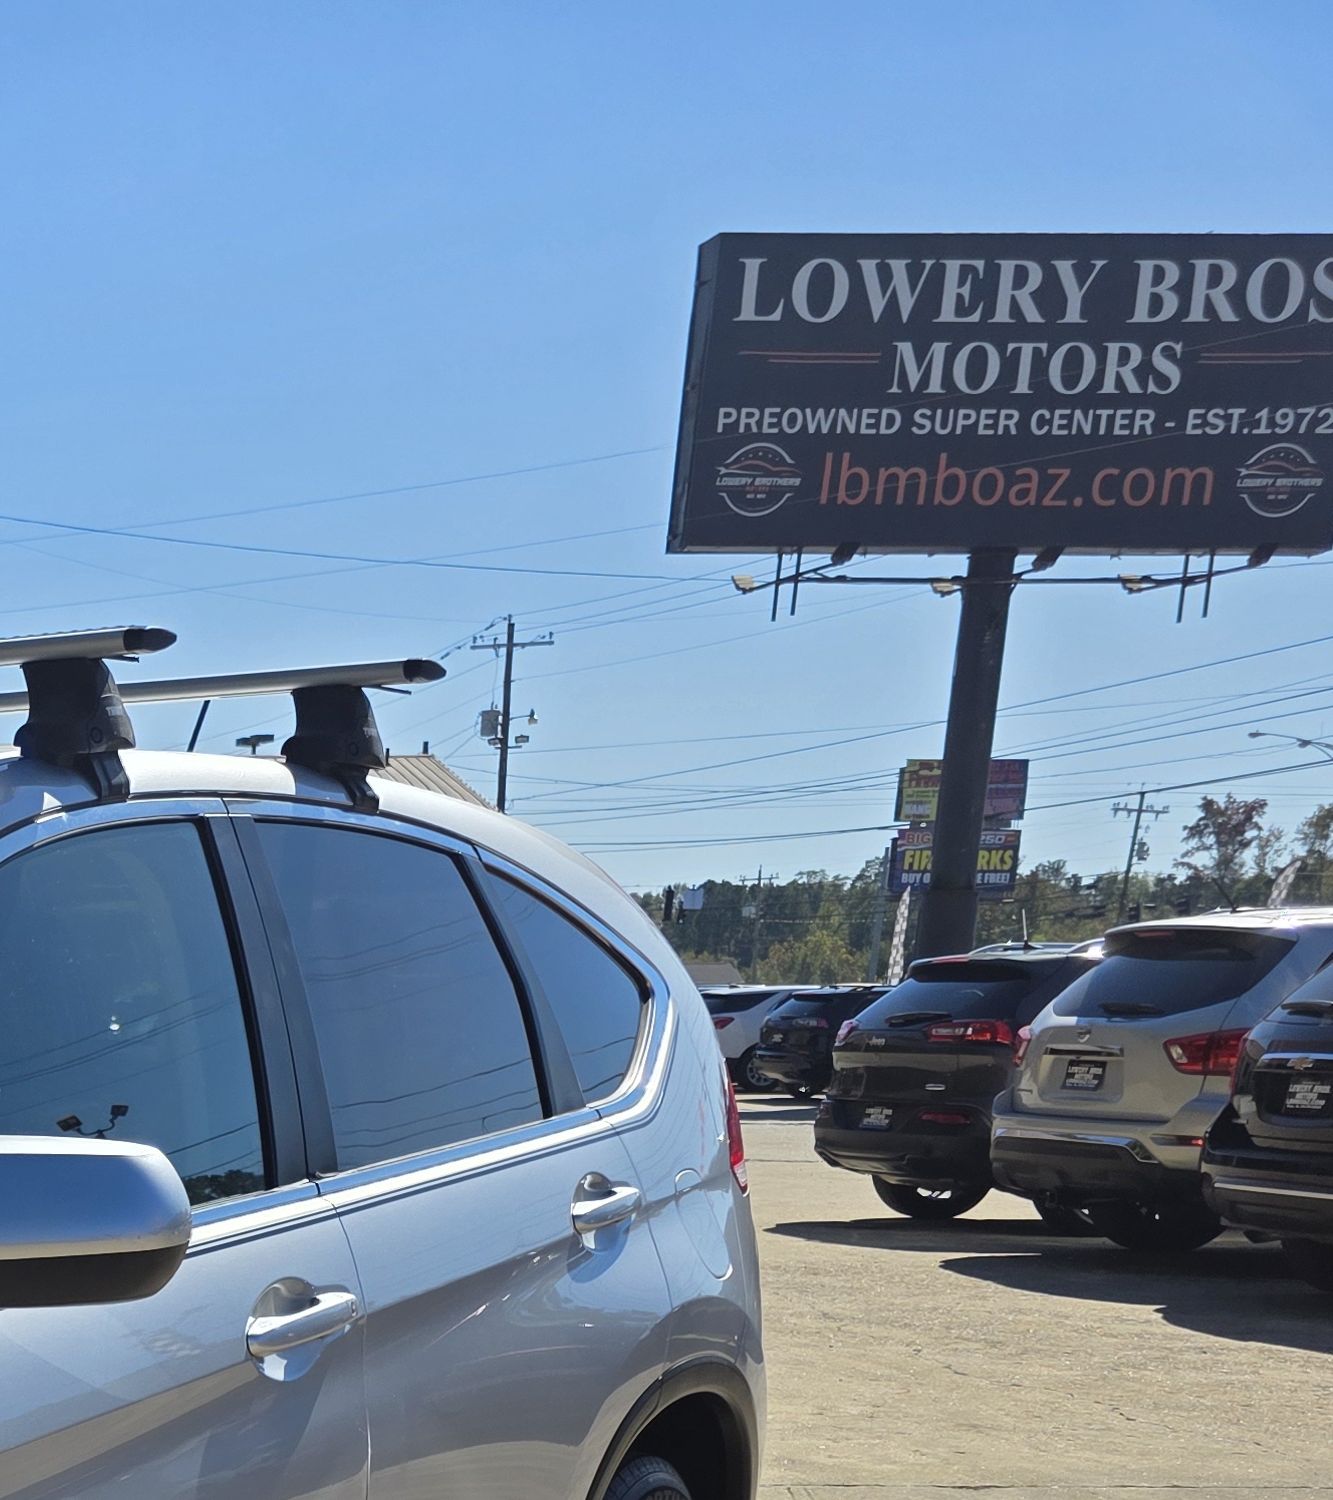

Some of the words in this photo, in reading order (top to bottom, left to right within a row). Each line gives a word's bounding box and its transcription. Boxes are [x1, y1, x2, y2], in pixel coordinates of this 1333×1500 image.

[732, 257, 1108, 324] LOWERY
[1125, 256, 1333, 325] BROS
[886, 341, 1183, 395] MOTORS
[716, 407, 902, 435] PREOWNED
[911, 408, 1020, 435] SUPER
[1028, 408, 1156, 436] CENTER
[1185, 406, 1333, 435] EST.1972
[819, 452, 1214, 507] lbmboaz.com
[906, 832, 932, 845] BIG
[901, 872, 922, 884] BUY
